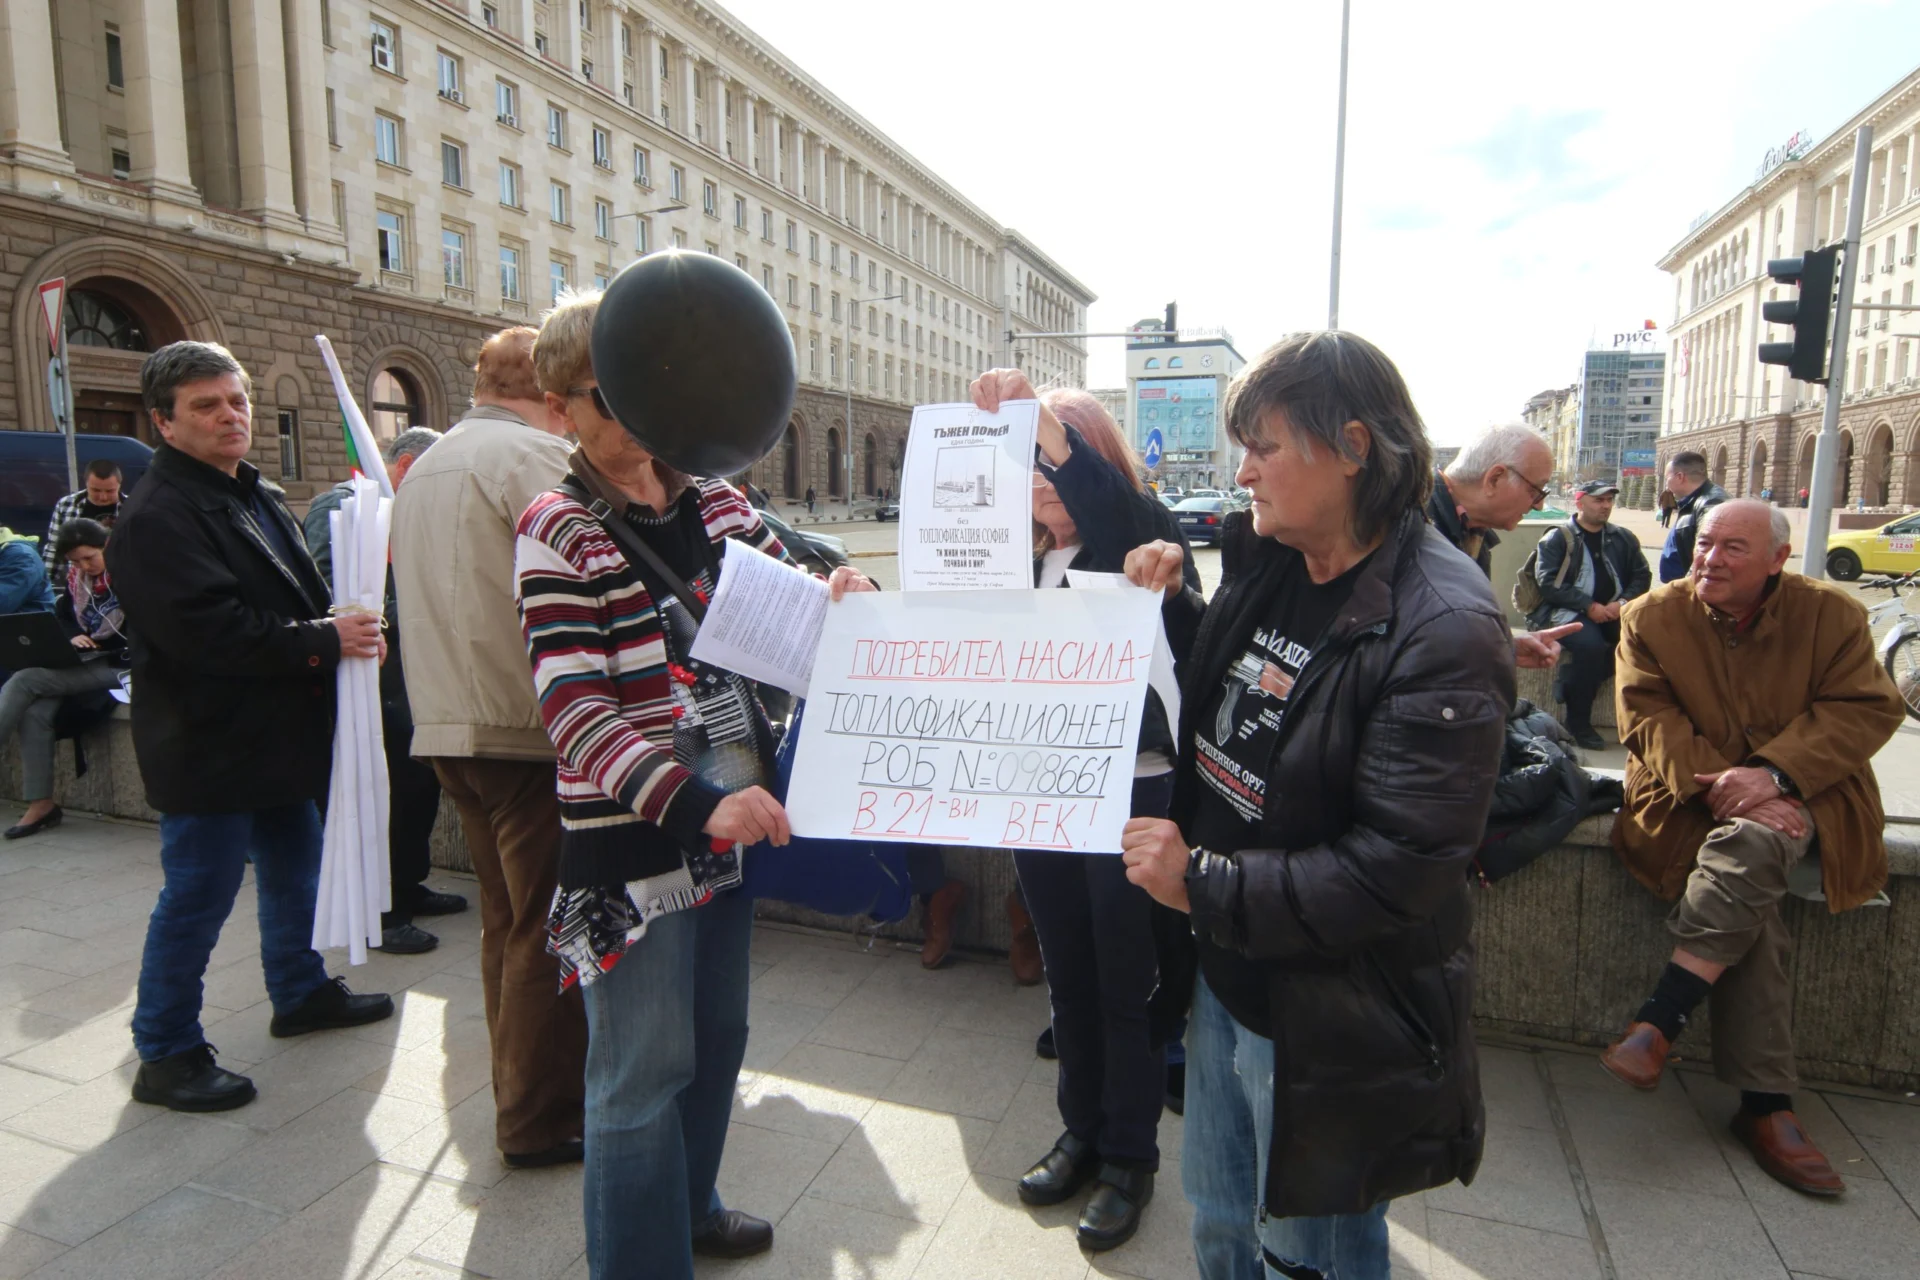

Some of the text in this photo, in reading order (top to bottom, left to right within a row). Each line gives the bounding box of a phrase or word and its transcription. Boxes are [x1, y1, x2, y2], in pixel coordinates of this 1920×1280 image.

[933, 424, 1010, 439] ТЪЖЕН ПОМЕН
[957, 517, 969, 526] без
[919, 528, 1010, 545] ТОПЛОФИКАЦИЯ СОФИЯ
[936, 549, 943, 557] ТИ
[944, 549, 958, 557] ЖИВИ
[959, 549, 967, 557] НИ
[943, 559, 967, 568] ПОЧИВАЙ
[852, 639, 1006, 678] ПОТРЕБИТЕЛ
[825, 691, 1129, 746] ТОПЛОФИКАЦИОНЕН
[860, 741, 940, 788] РОБ
[852, 791, 879, 832] В
